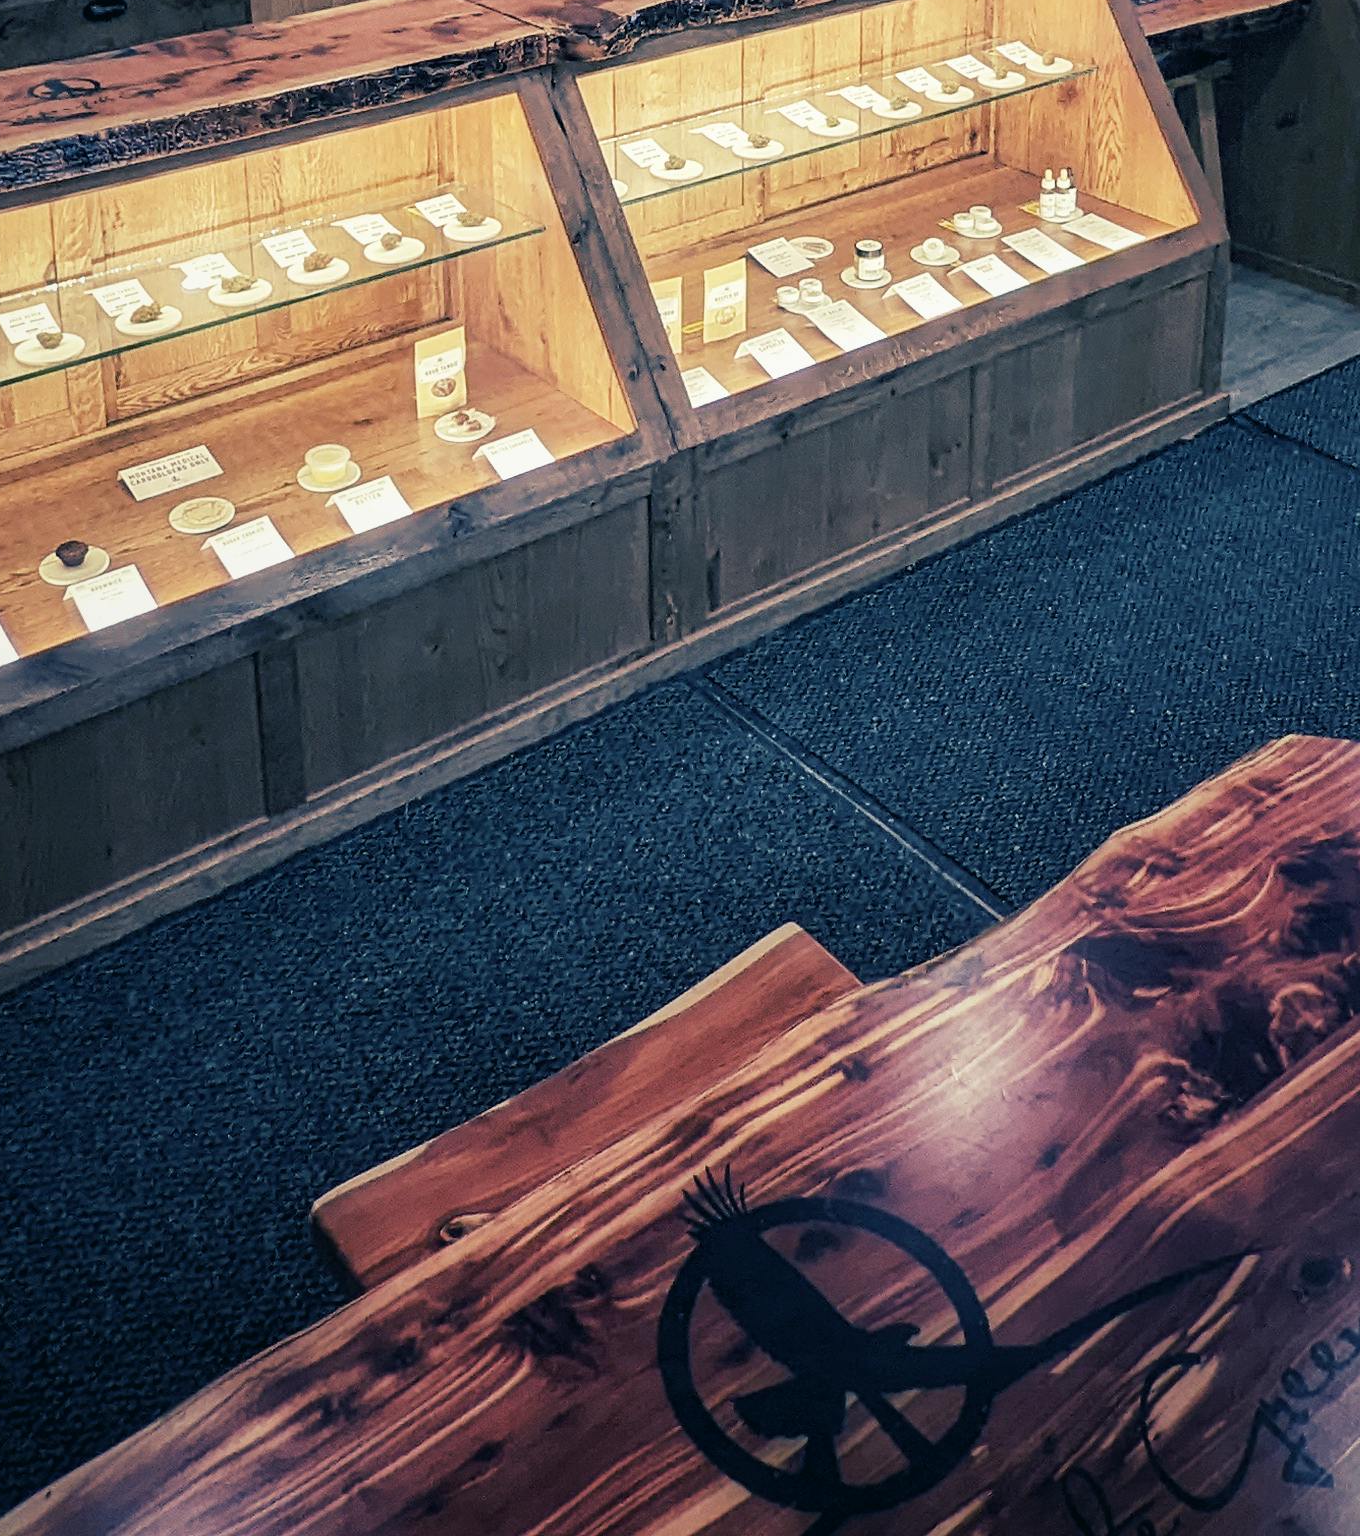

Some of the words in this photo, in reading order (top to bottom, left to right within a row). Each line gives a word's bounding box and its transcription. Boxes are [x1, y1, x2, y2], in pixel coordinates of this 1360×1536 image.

[128, 463, 168, 480] MONTANA
[171, 452, 206, 467] MEDICAL
[130, 464, 189, 487] CARDHOLDERS
[190, 456, 211, 469] ONLY
